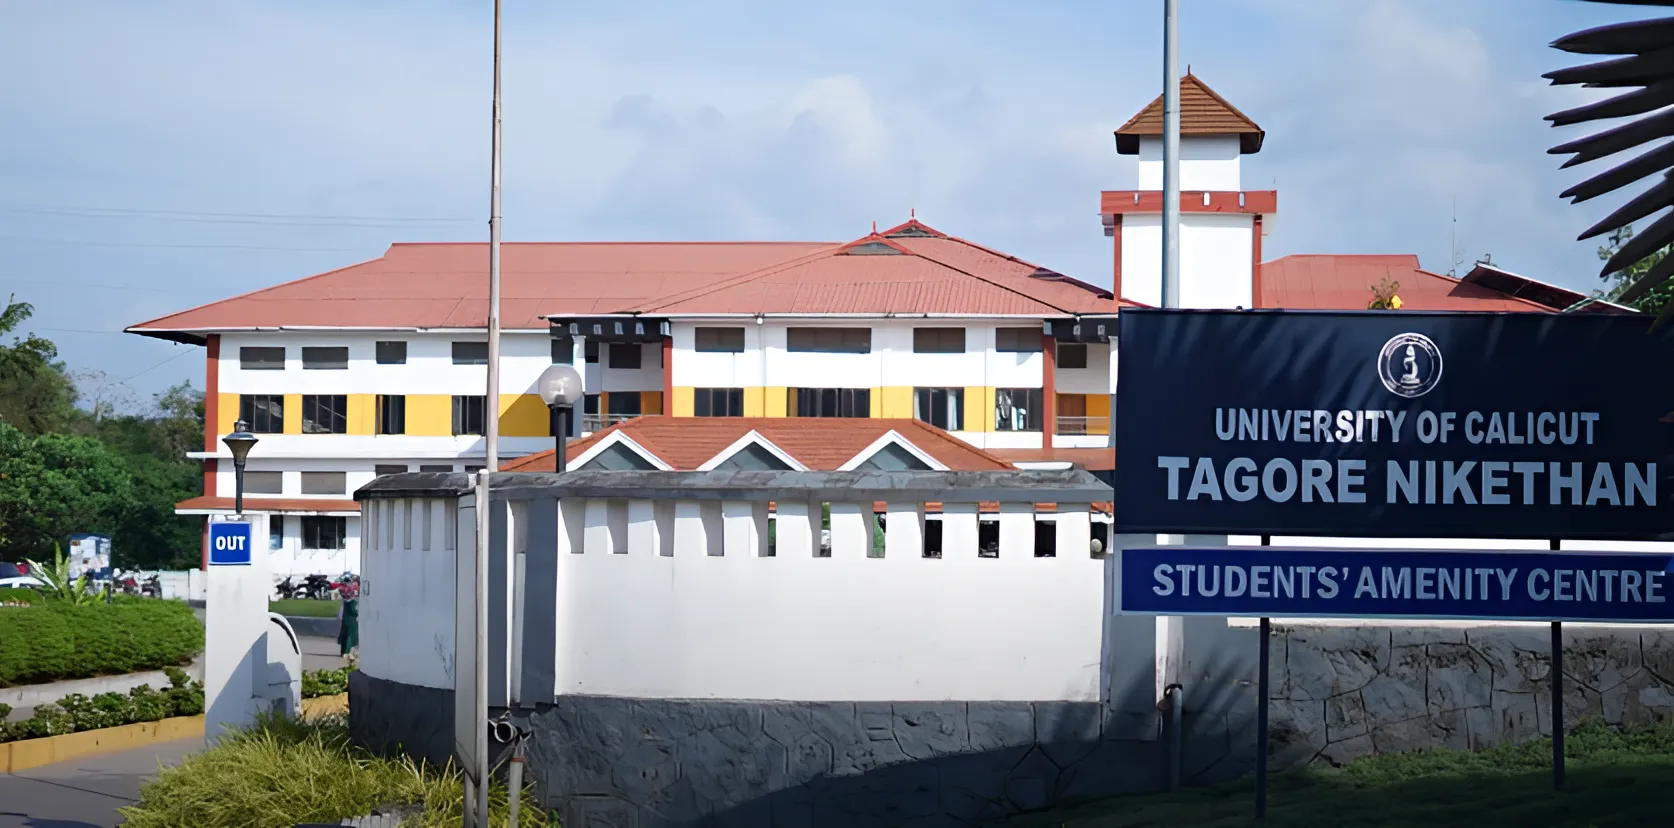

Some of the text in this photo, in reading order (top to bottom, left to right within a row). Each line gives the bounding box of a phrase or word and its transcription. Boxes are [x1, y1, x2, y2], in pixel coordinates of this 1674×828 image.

[1215, 407, 1600, 445] UNIVERSITY OF CALICUT
[1157, 455, 1658, 506] TAGORE NIKETHAN
[215, 535, 246, 551] OUT
[1354, 566, 1519, 601] AMENITY
[1526, 567, 1667, 603] CENTRE
